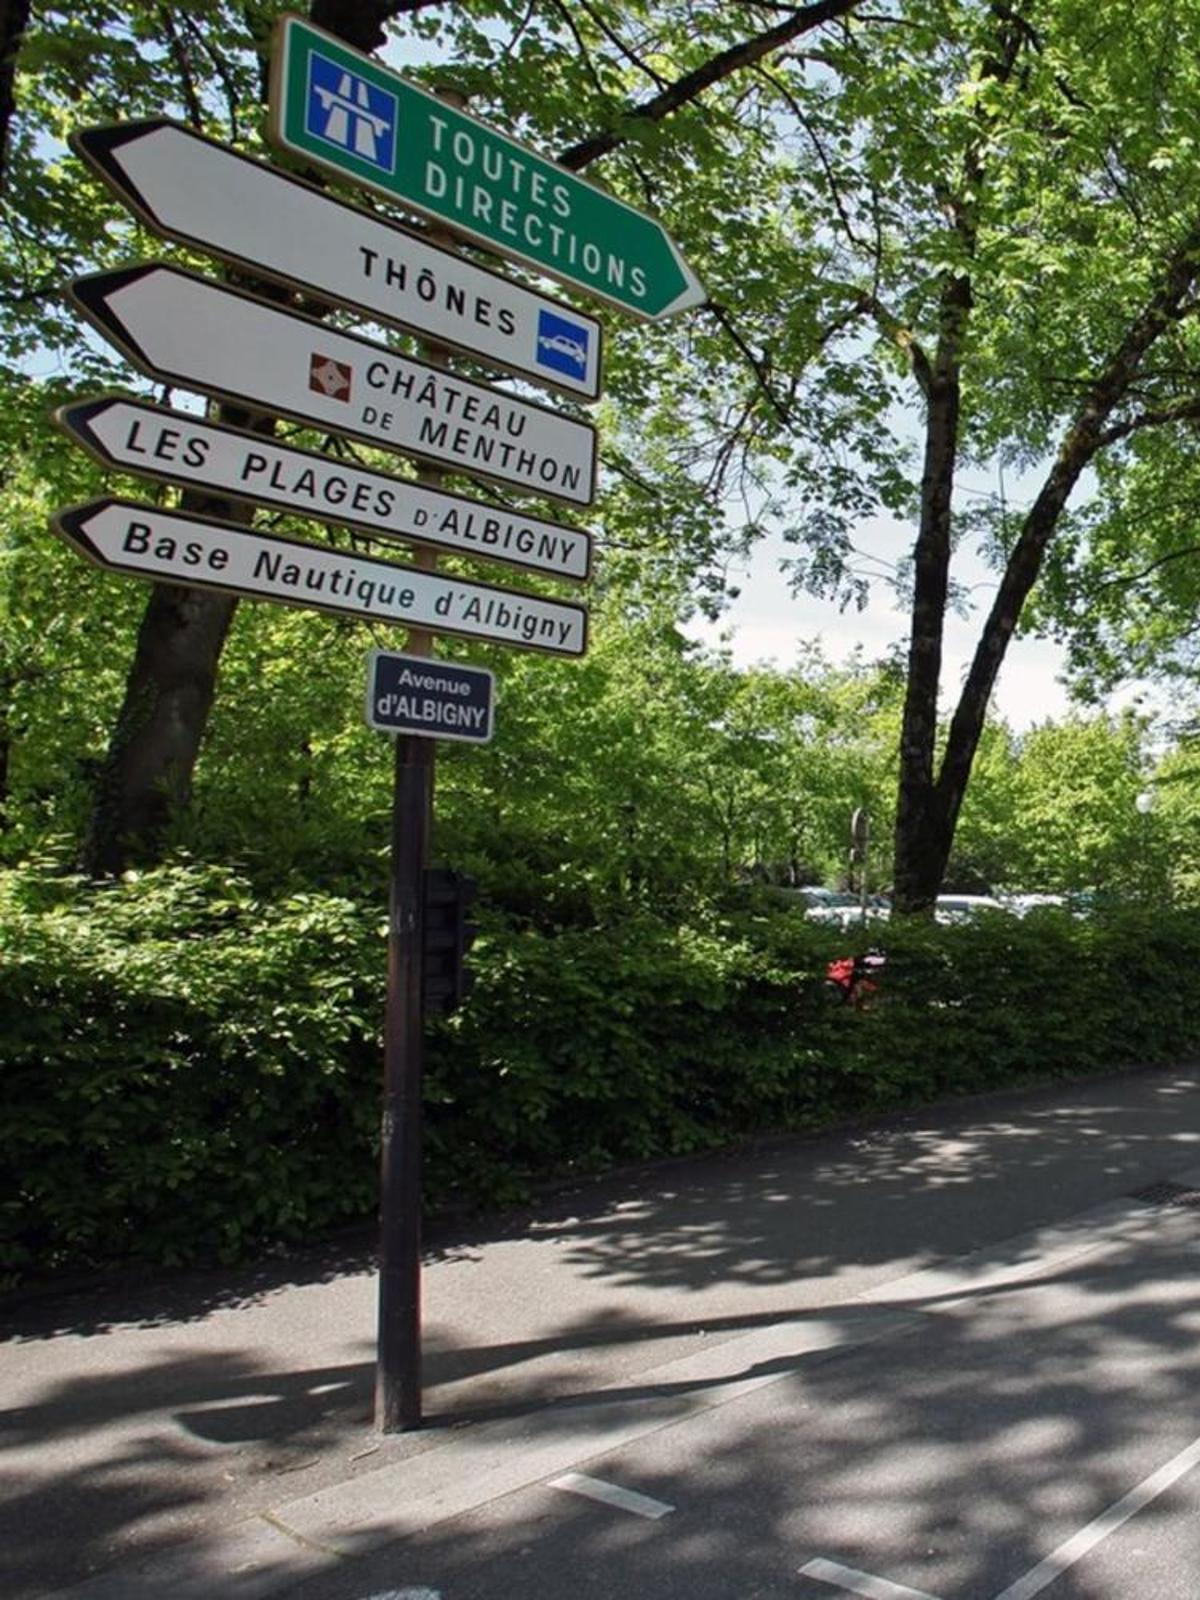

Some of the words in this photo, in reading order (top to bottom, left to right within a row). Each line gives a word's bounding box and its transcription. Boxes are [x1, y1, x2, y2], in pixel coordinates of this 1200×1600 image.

[427, 114, 572, 218] TOUTES
[425, 160, 648, 299] DIRECTIONS
[358, 246, 516, 336] THÔNES
[365, 362, 527, 438] CHÂTEAU
[125, 420, 211, 468] LES
[241, 453, 396, 518] PLAGES
[361, 406, 393, 432] DE
[419, 417, 582, 491] MENTHON
[122, 521, 230, 570] Base
[253, 550, 416, 610] Nautique
[434, 590, 574, 645] d'Albigny
[377, 694, 485, 730] d'ALBIGNY
[398, 668, 471, 697] Avenue
